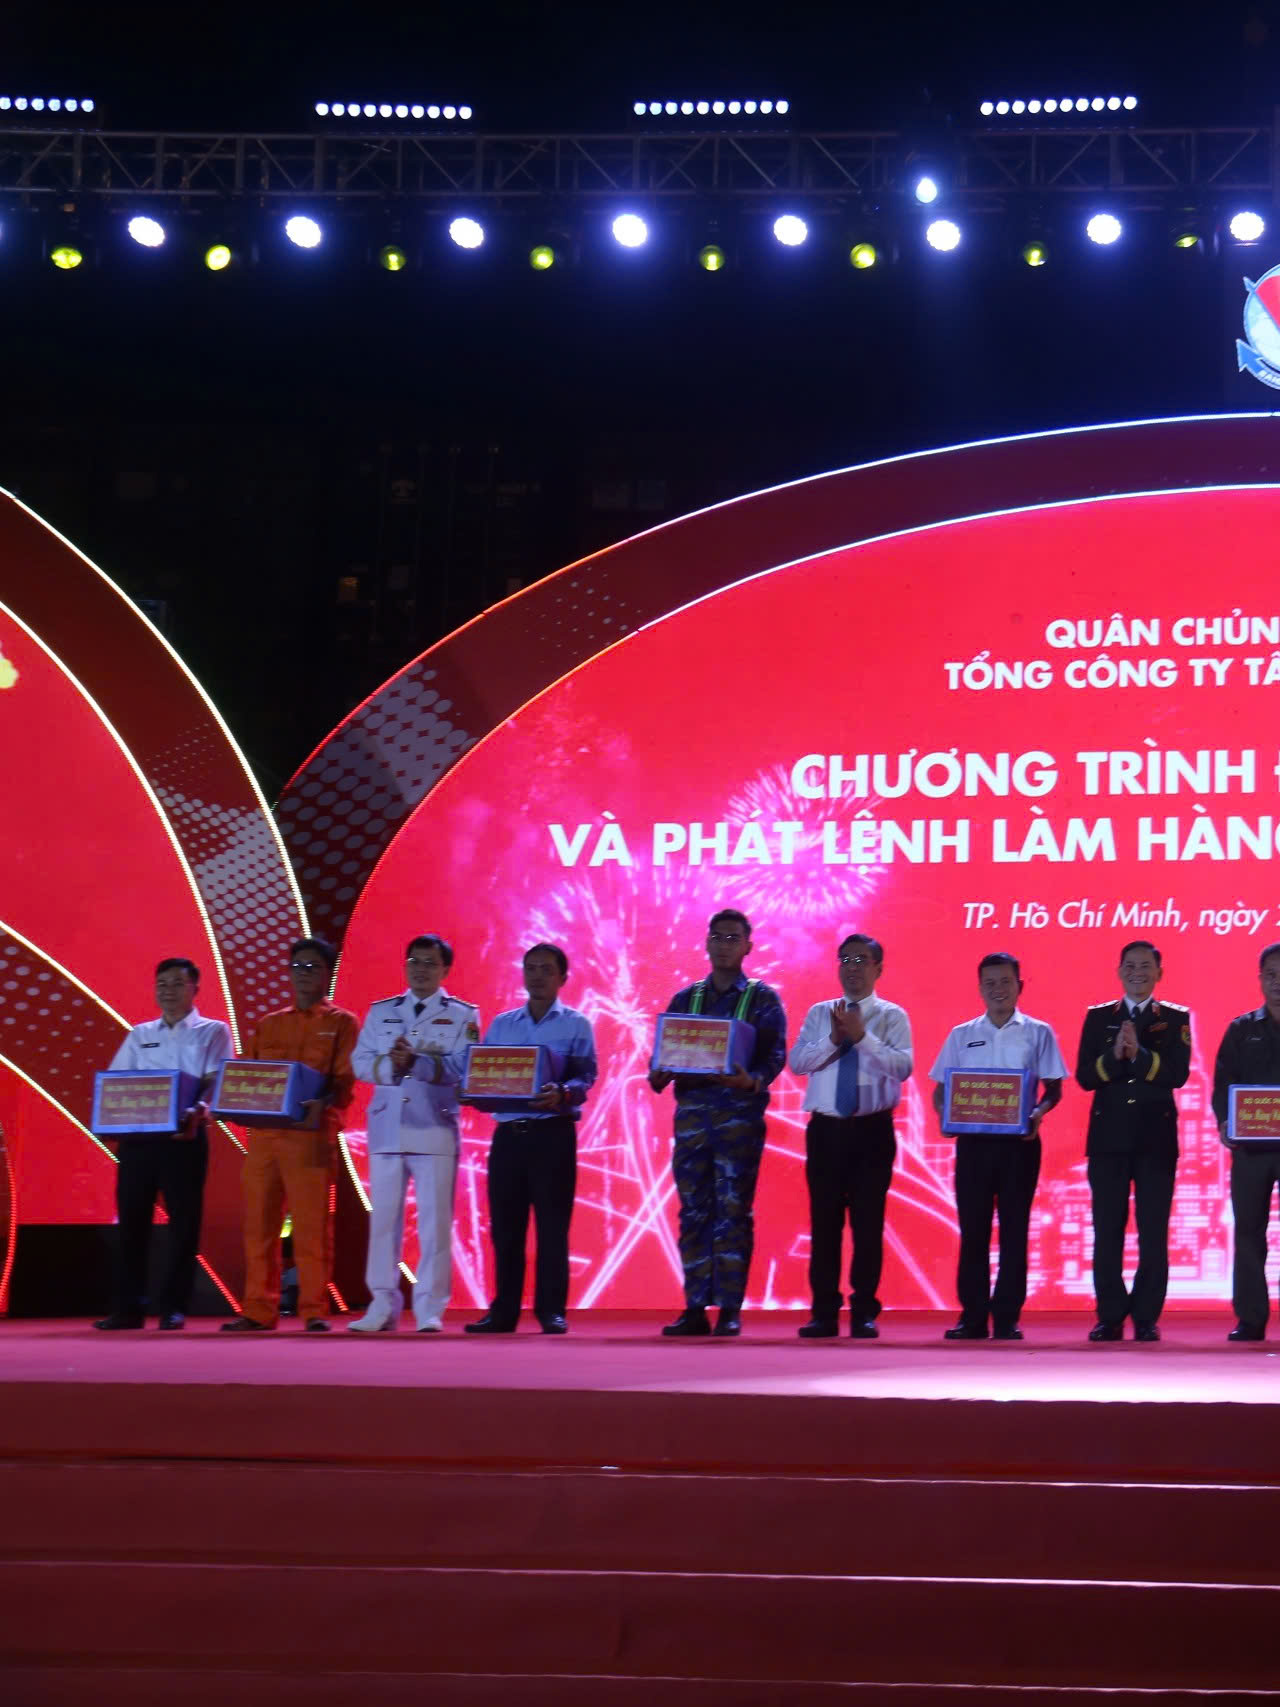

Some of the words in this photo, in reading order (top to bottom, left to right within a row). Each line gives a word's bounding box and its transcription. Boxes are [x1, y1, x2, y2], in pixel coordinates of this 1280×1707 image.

[1045, 612, 1160, 649] QUÂN
[944, 650, 1053, 691] TỔNG
[1064, 653, 1178, 689] CÔNG
[1188, 658, 1233, 687] TY
[790, 747, 1058, 800] CHƯƠNG
[1076, 737, 1256, 796] TRÌNH
[548, 810, 637, 868] VÀ
[651, 810, 804, 867] PHÁT
[821, 808, 971, 875] LỆNH
[992, 805, 1117, 863] LÀM
[963, 902, 999, 929] TP.
[1009, 902, 1049, 929] Hồ
[1058, 898, 1103, 929] Chí
[1111, 897, 1189, 932] Minh,
[1198, 901, 1269, 935] ngày
